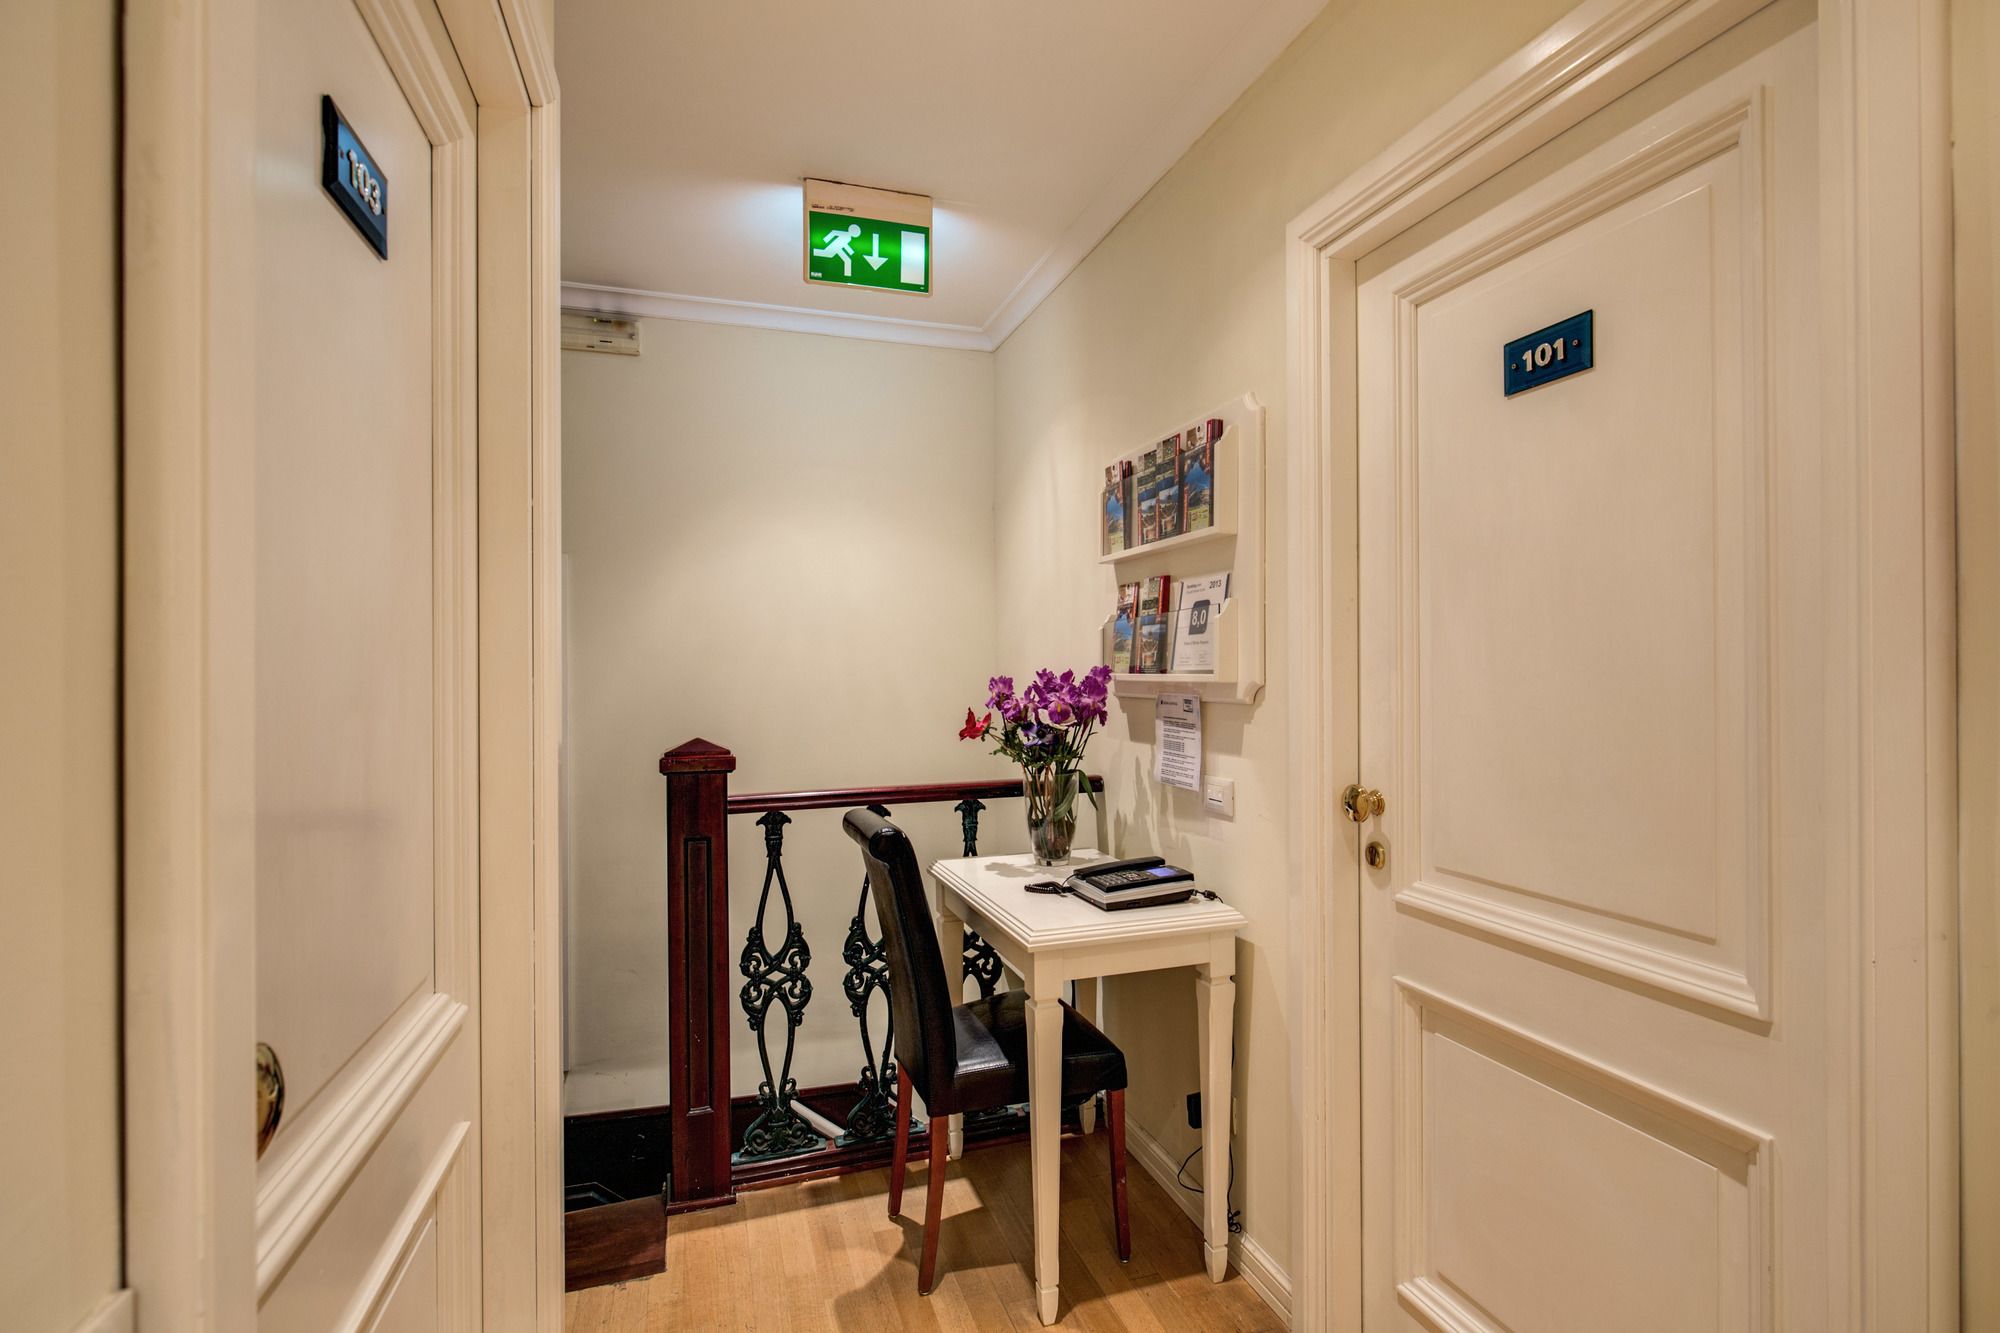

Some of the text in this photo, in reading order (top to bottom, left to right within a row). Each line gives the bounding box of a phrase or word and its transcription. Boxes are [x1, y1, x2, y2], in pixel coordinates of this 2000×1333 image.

[348, 149, 382, 216] 103
[1521, 337, 1565, 372] 101
[1209, 579, 1222, 590] 2013
